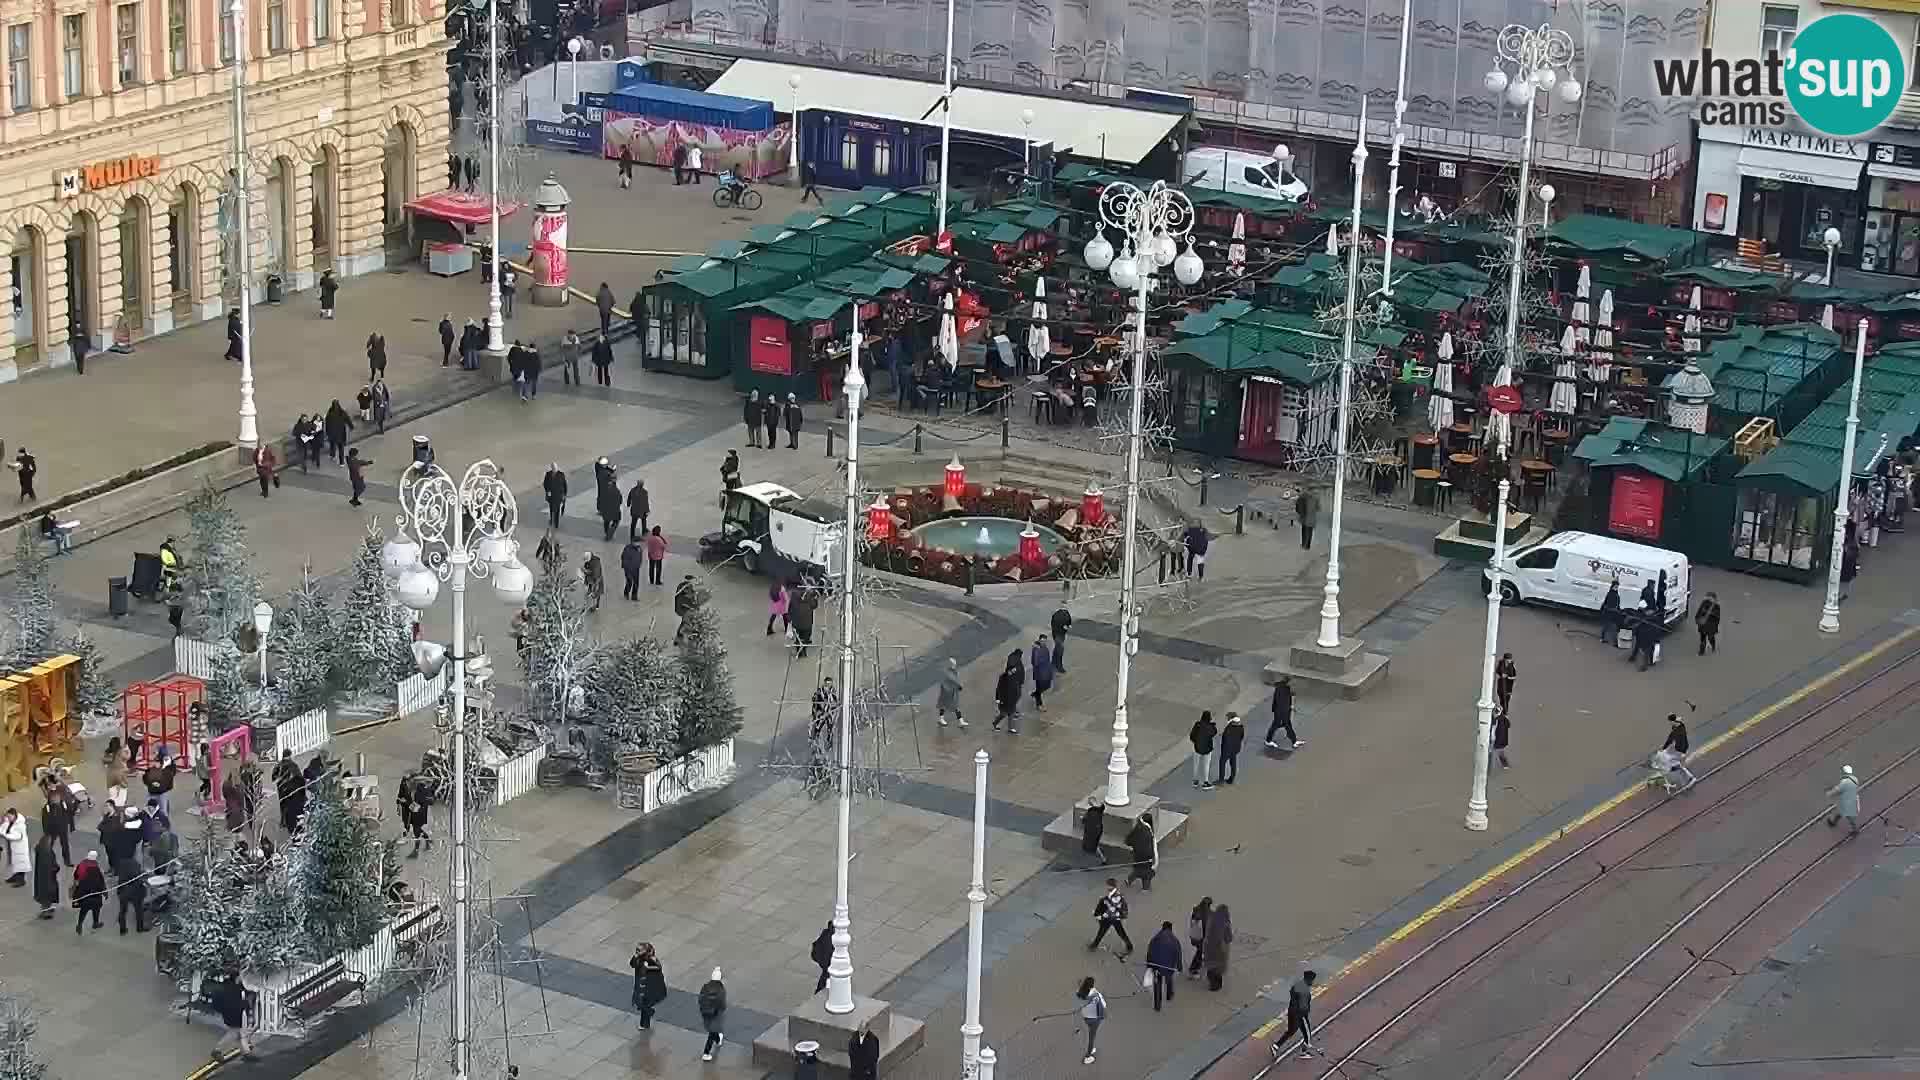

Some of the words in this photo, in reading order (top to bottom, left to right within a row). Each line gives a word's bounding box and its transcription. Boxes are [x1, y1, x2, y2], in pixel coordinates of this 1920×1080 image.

[1748, 128, 1859, 156] MARTIMEX
[82, 153, 160, 190] Müller
[1778, 172, 1815, 184] CHANEL
